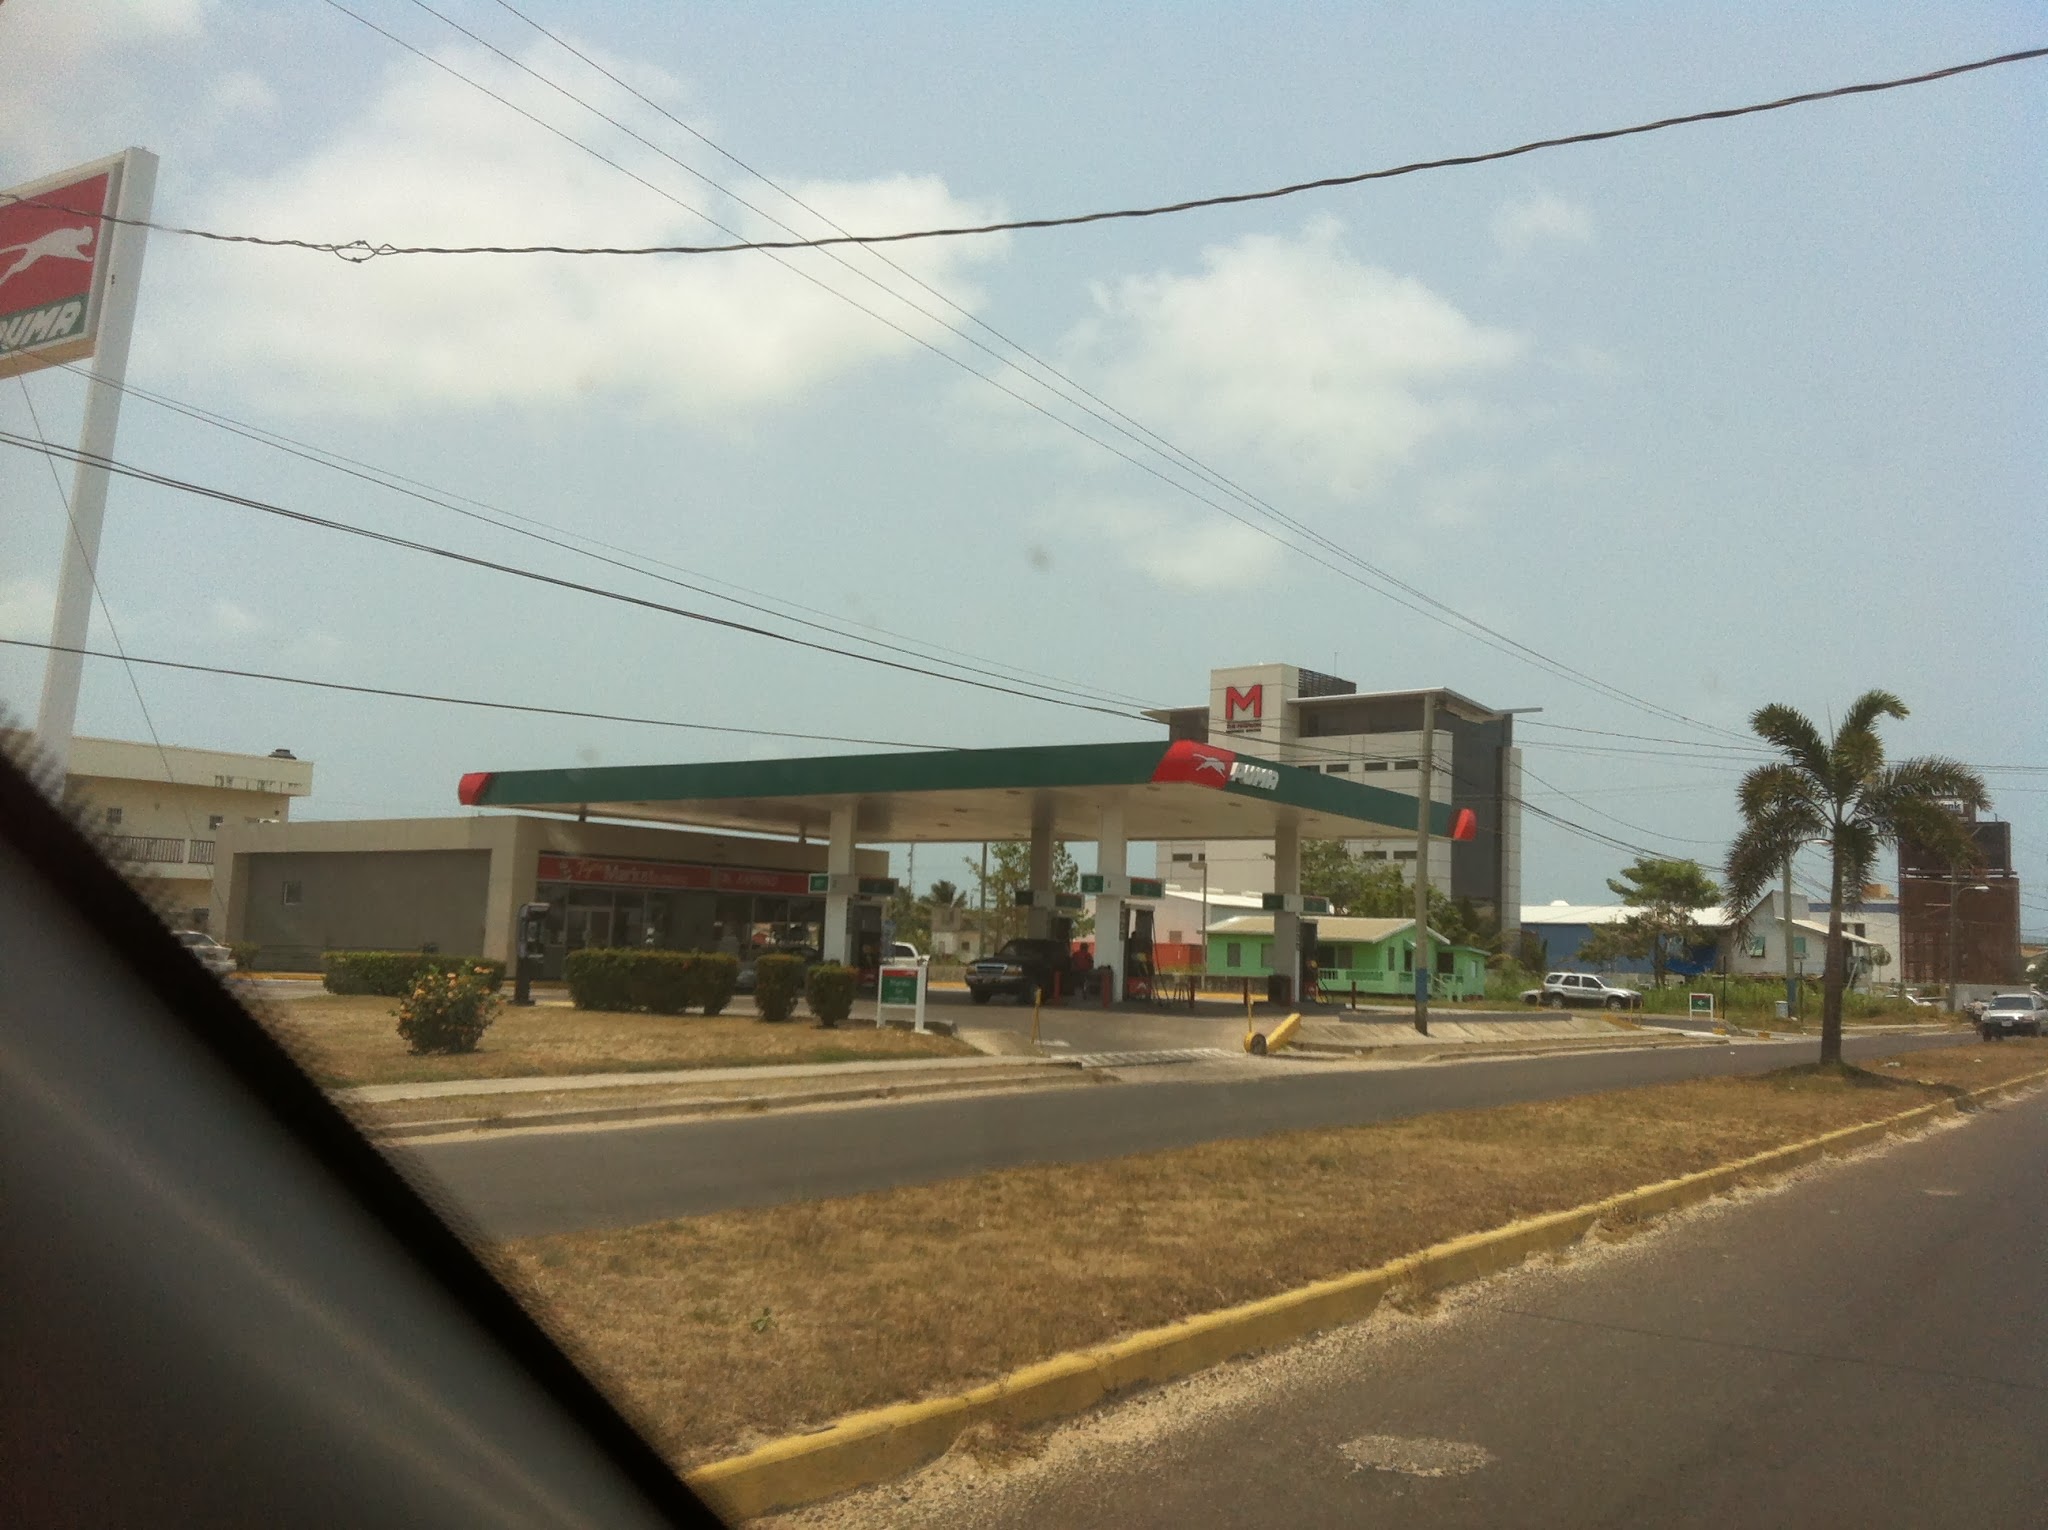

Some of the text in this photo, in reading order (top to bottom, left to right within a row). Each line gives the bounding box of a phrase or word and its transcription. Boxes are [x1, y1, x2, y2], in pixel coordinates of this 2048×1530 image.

[0, 301, 82, 350] UMA
[1226, 684, 1263, 721] M
[1228, 762, 1280, 791] PUMA
